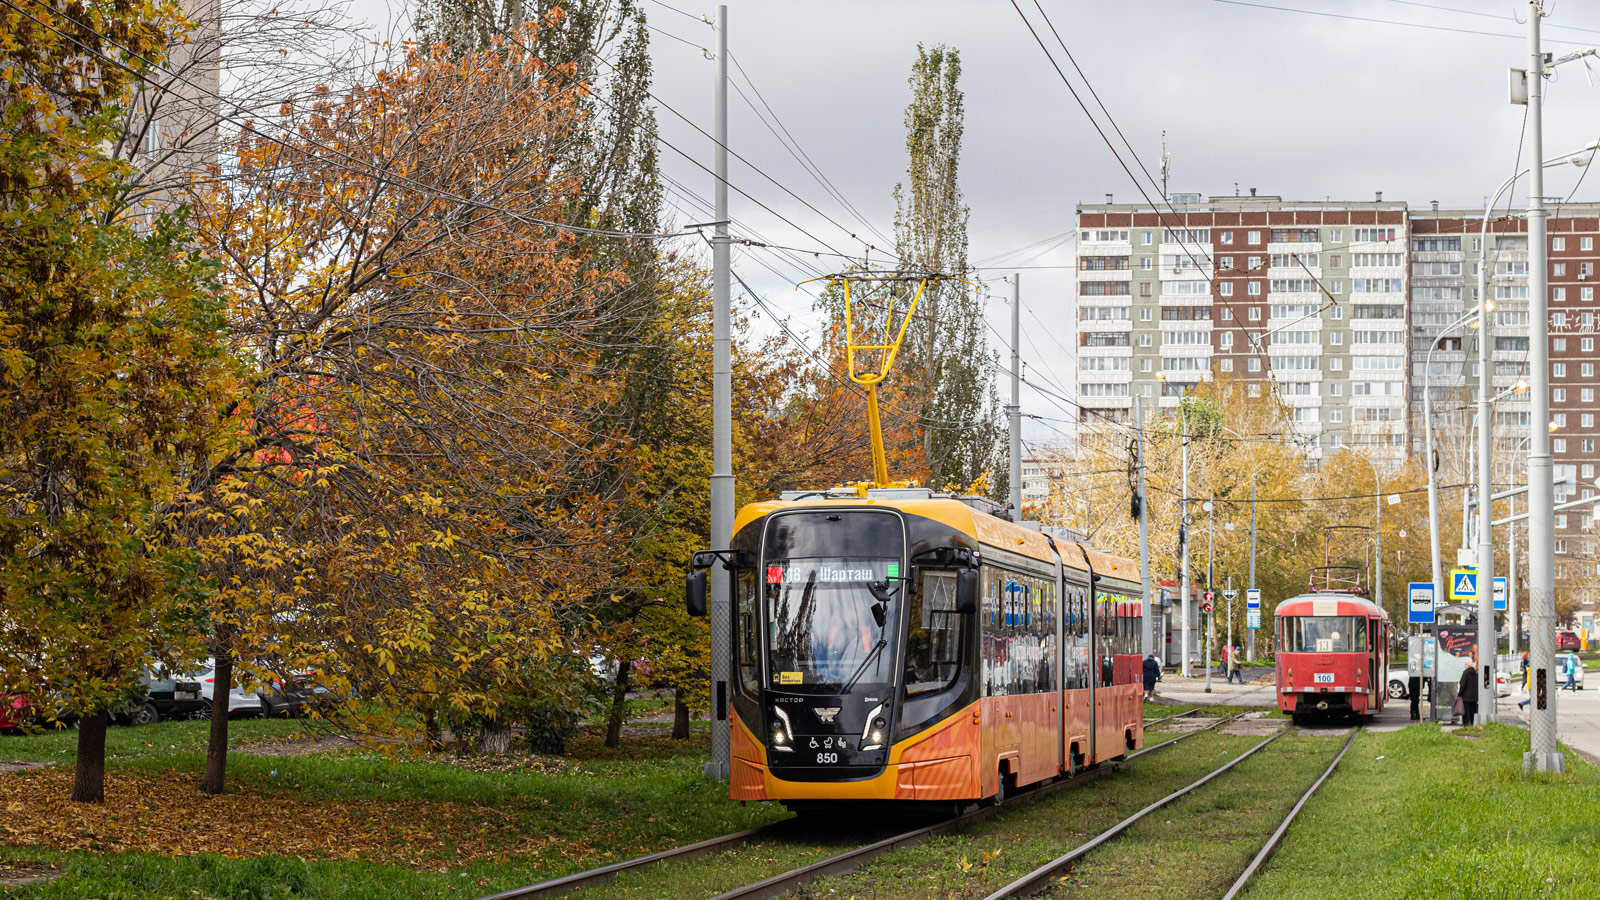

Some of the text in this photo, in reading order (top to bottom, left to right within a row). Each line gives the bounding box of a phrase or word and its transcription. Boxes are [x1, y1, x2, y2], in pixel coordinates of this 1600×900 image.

[787, 567, 873, 582] 18 Шарташ
[1319, 640, 1329, 651] 13
[816, 752, 838, 764] 850
